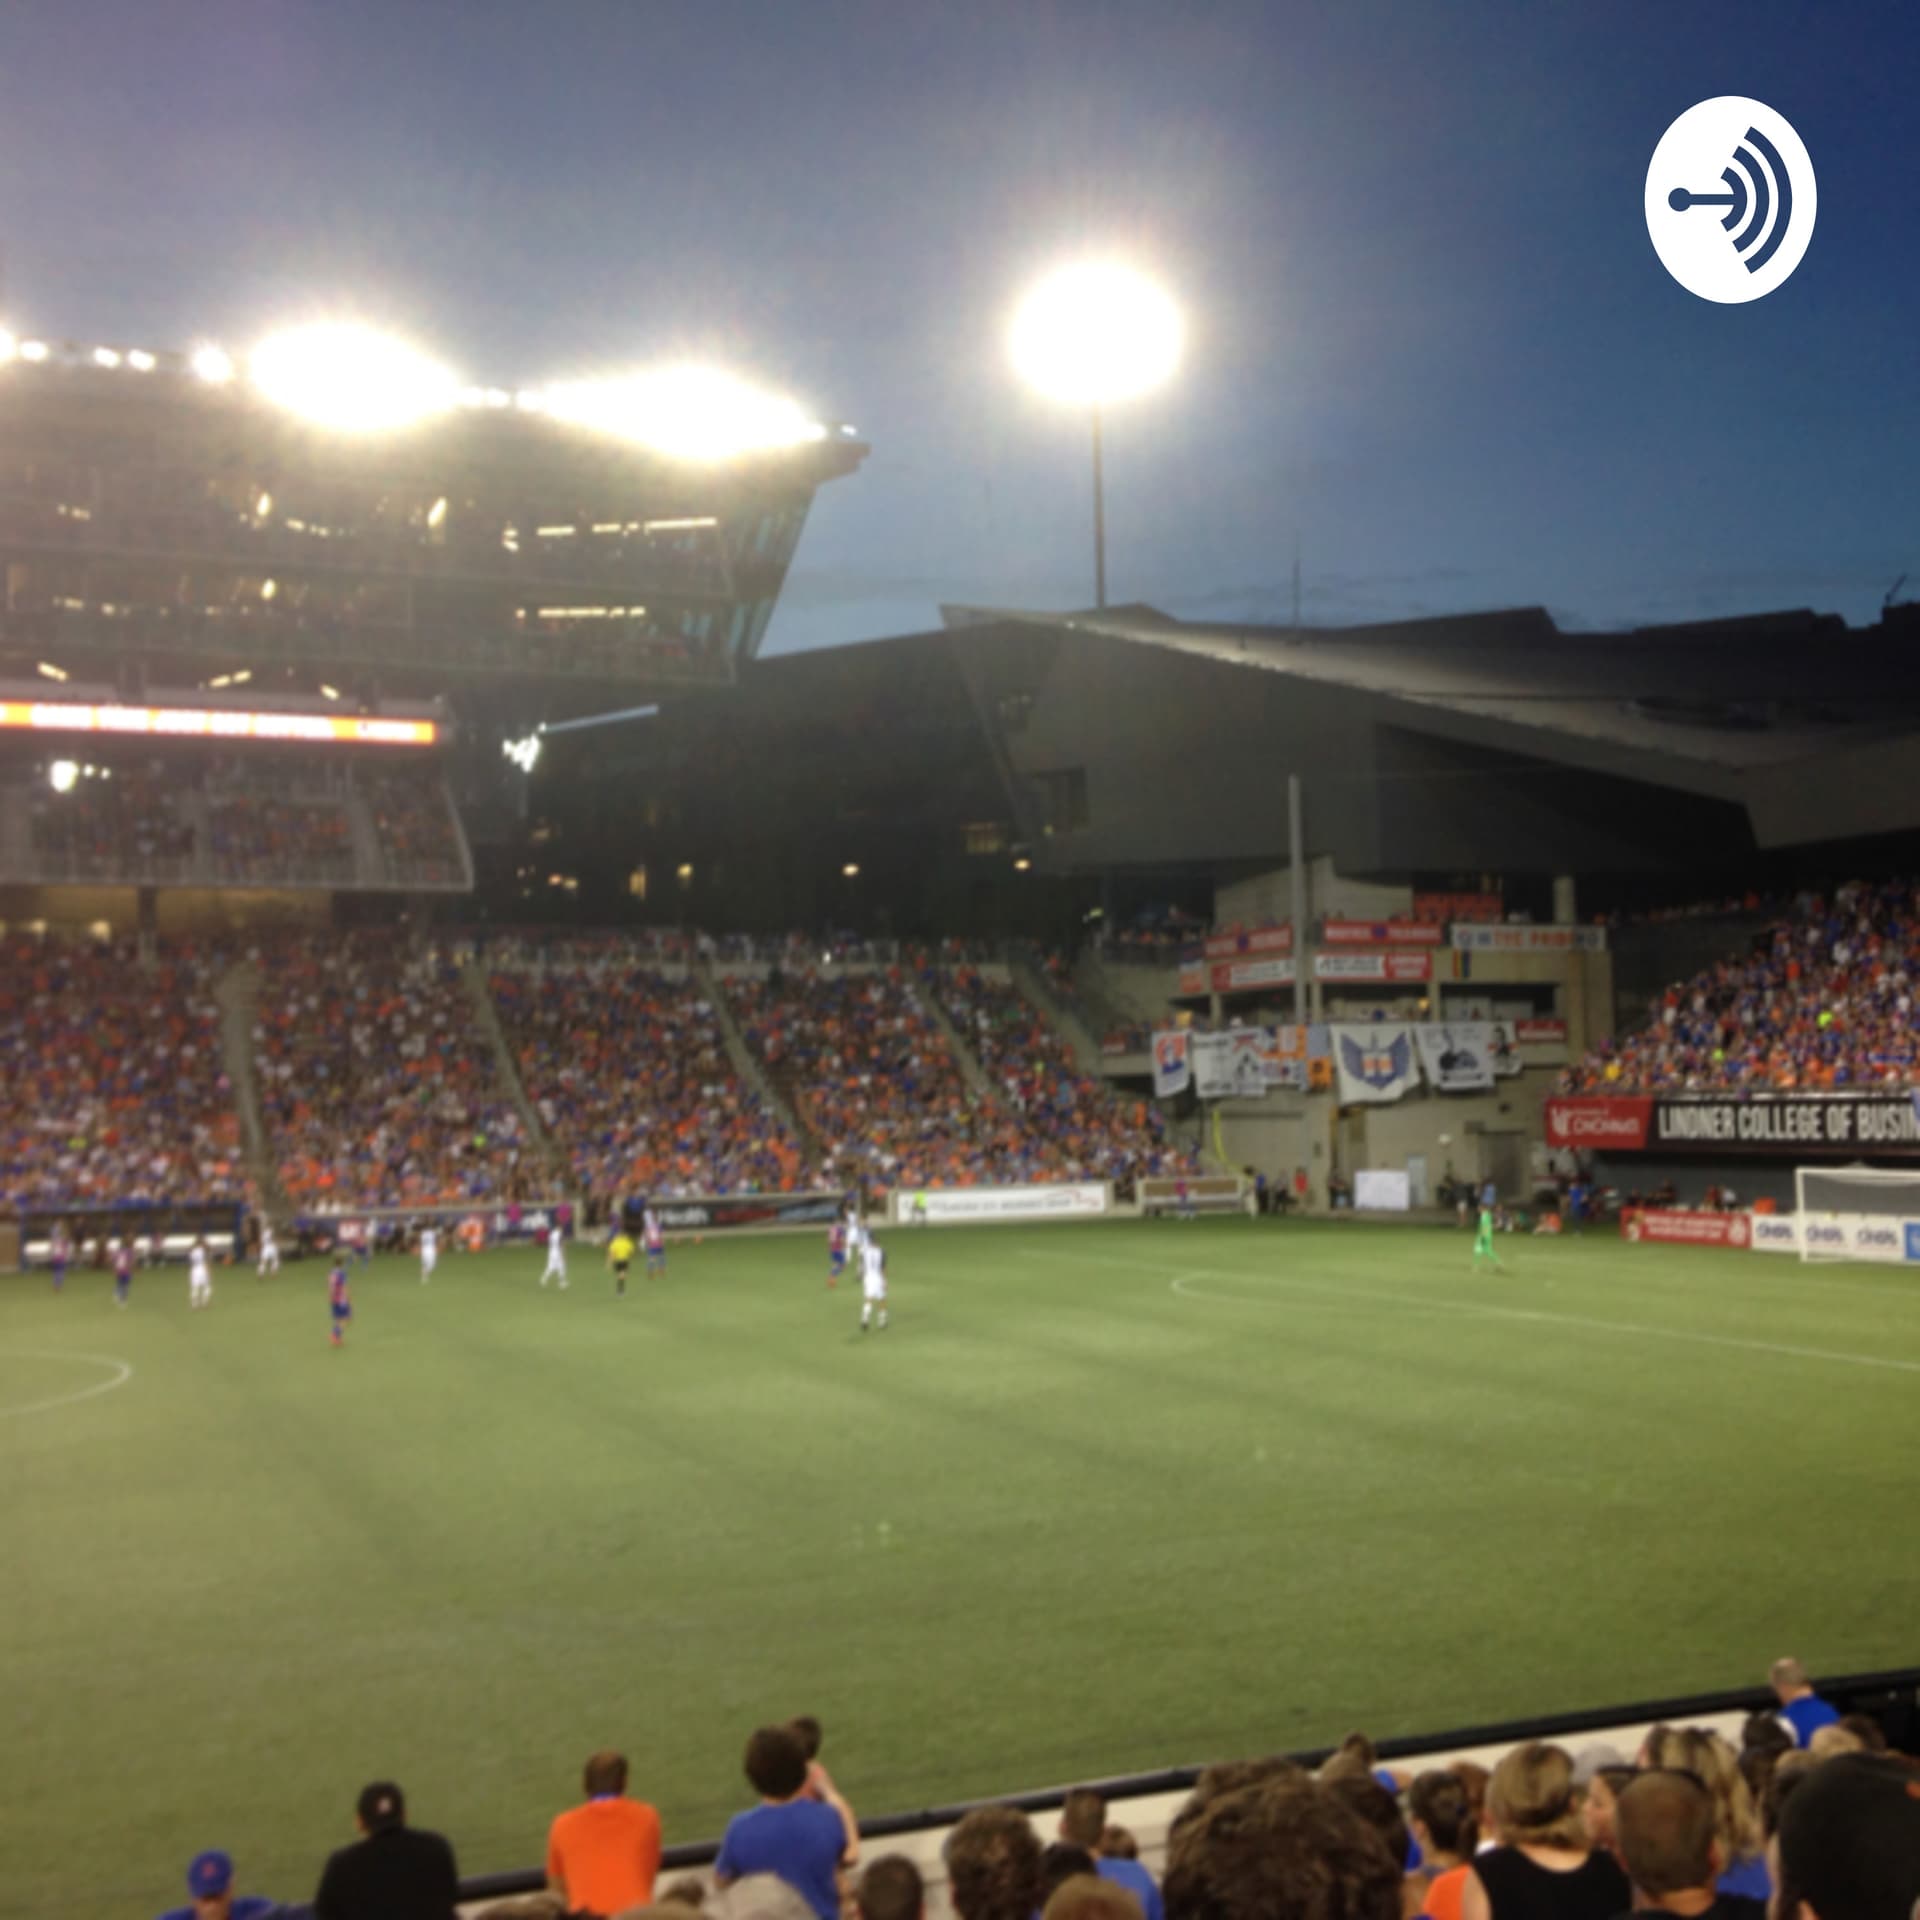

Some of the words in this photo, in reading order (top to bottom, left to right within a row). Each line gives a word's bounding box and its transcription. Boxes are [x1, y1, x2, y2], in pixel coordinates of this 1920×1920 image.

[1658, 1105, 1735, 1139] LINDNER
[1738, 1105, 1822, 1140] COLLEGE
[1826, 1105, 1852, 1140] OF
